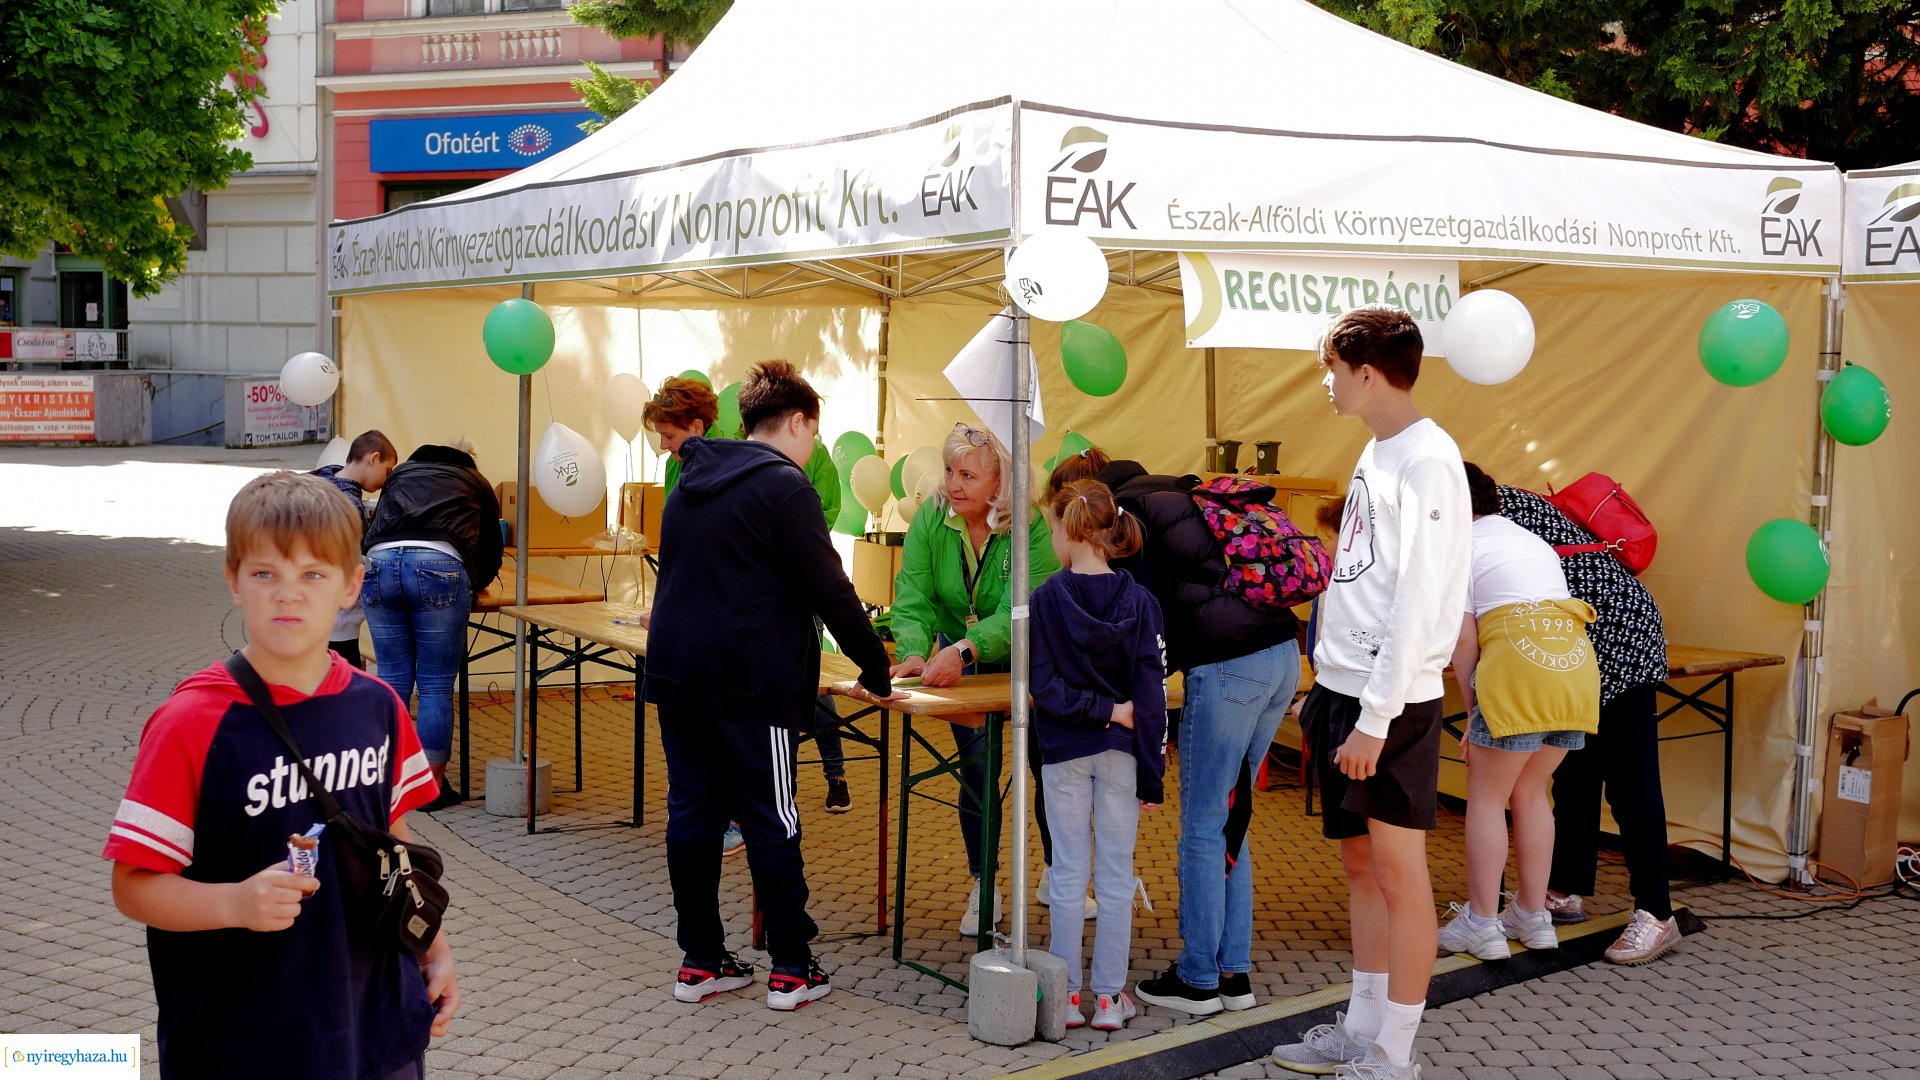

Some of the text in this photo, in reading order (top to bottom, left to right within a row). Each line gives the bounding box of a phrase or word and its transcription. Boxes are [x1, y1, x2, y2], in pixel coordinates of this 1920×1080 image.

[425, 131, 500, 155] Ofotért
[352, 164, 898, 278] Észak-Alföldi Környezetgazdálkodási Nonprofit Kft.
[1167, 199, 1741, 255] Észak-Alföldi Környezetgazdálkodási Nonprofit Kft.
[1865, 226, 1920, 266] EA
[1224, 269, 1452, 321] REGISZTRÁCIÓ
[256, 431, 299, 443] TOM TAILOR
[1516, 636, 1586, 668] BROOKLYN
[244, 734, 390, 817] stunned
[770, 981, 785, 989] AIR
